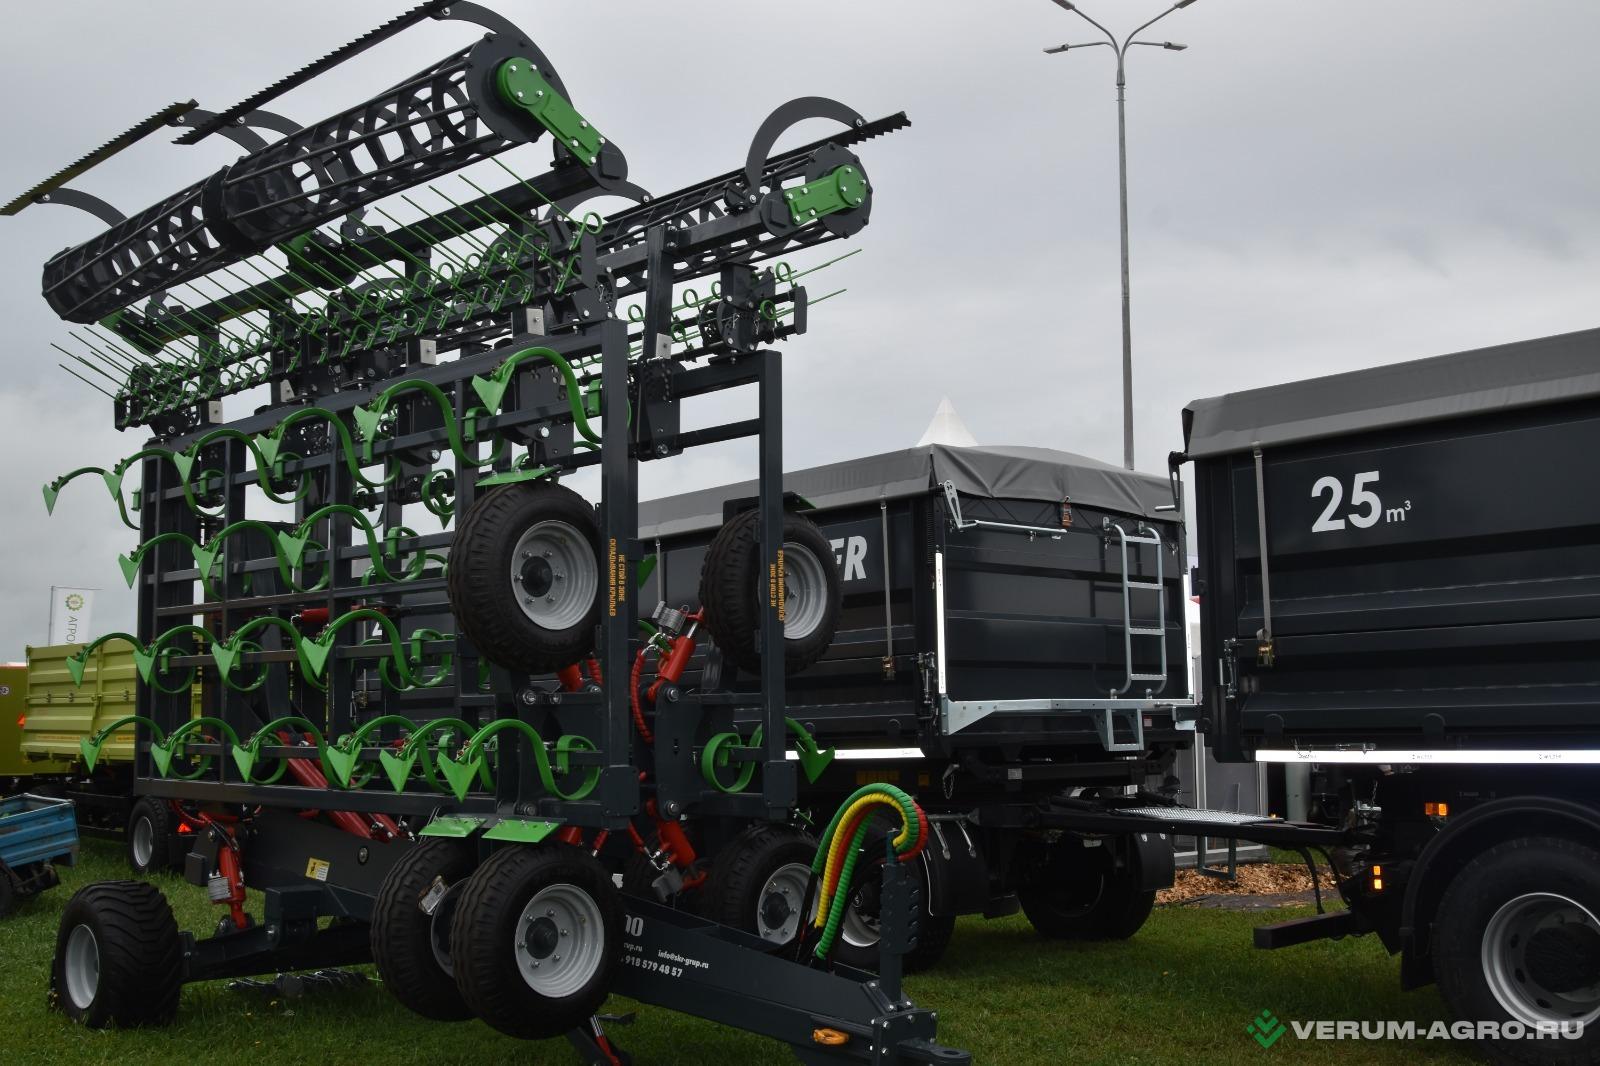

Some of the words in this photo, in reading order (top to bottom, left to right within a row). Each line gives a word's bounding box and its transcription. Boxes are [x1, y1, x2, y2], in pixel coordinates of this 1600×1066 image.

[1311, 470, 1382, 533] 25
[618, 554, 625, 562] НЕ
[618, 563, 626, 579] СТОЙ
[770, 599, 777, 607] НЕ
[66, 615, 78, 643] АГРО
[642, 959, 658, 971] 579
[659, 964, 670, 975] 48
[671, 967, 683, 978] 57
[658, 949, 709, 969] info@skr-grup.ru
